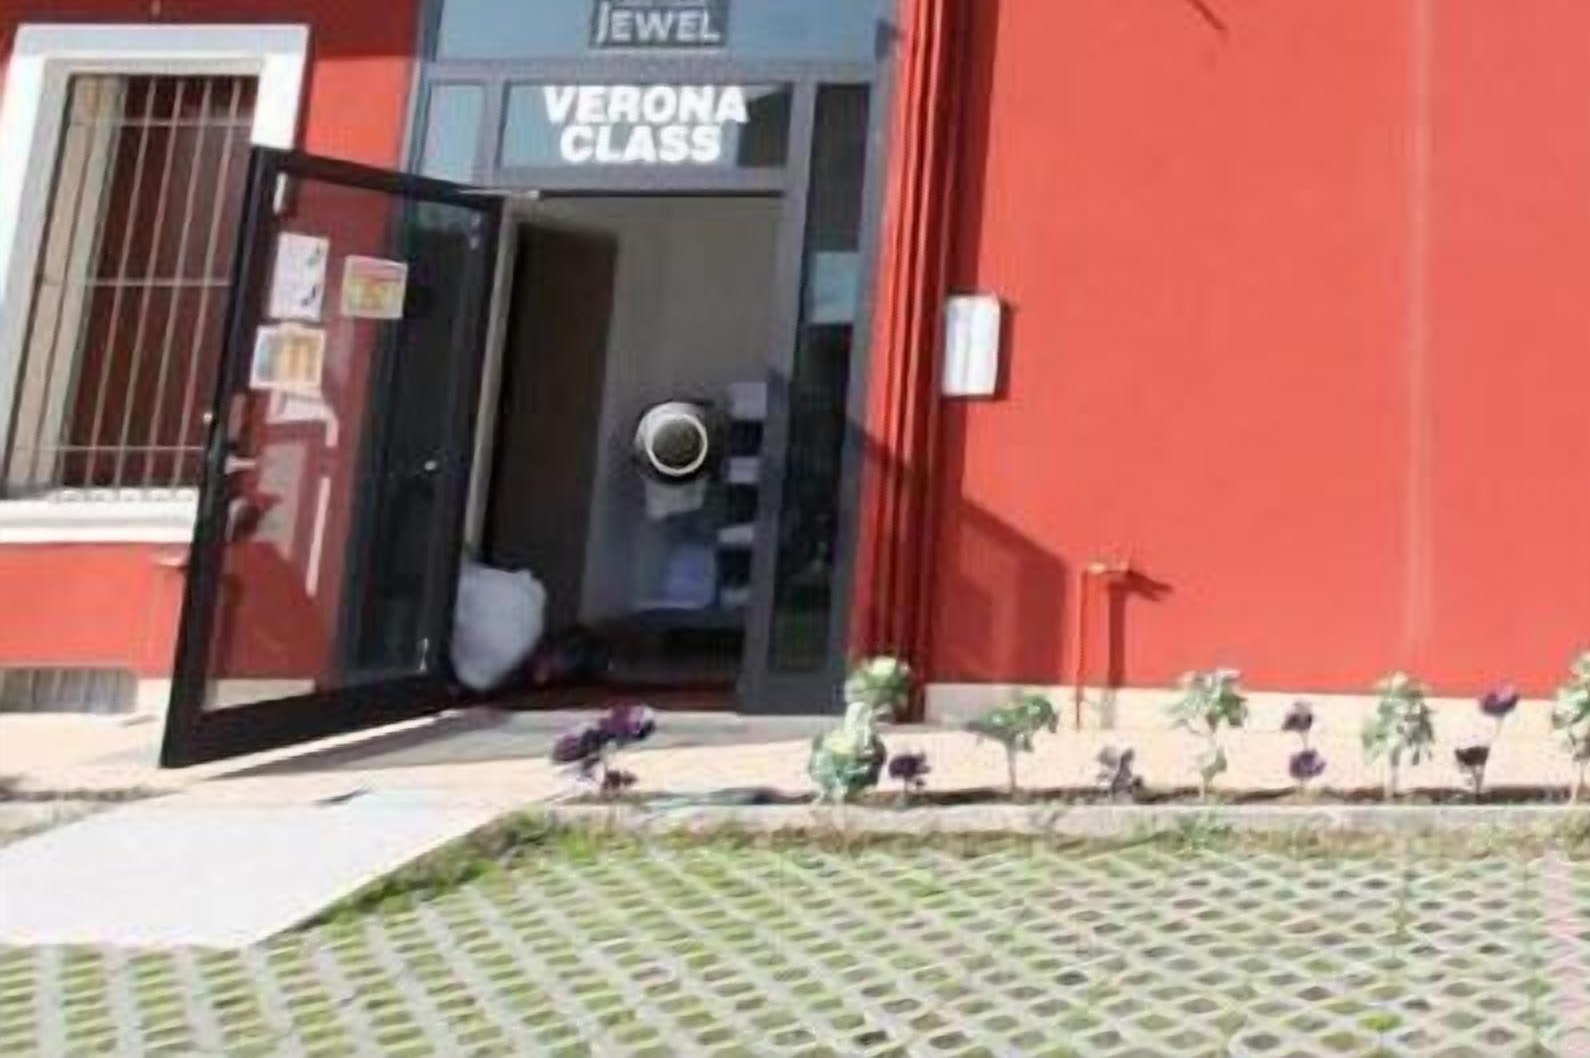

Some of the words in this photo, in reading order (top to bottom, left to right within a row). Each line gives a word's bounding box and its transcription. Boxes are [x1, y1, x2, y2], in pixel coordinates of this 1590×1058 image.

[596, 1, 720, 43] JEWEL
[544, 85, 749, 124] VERONA
[560, 125, 722, 162] CLASS
